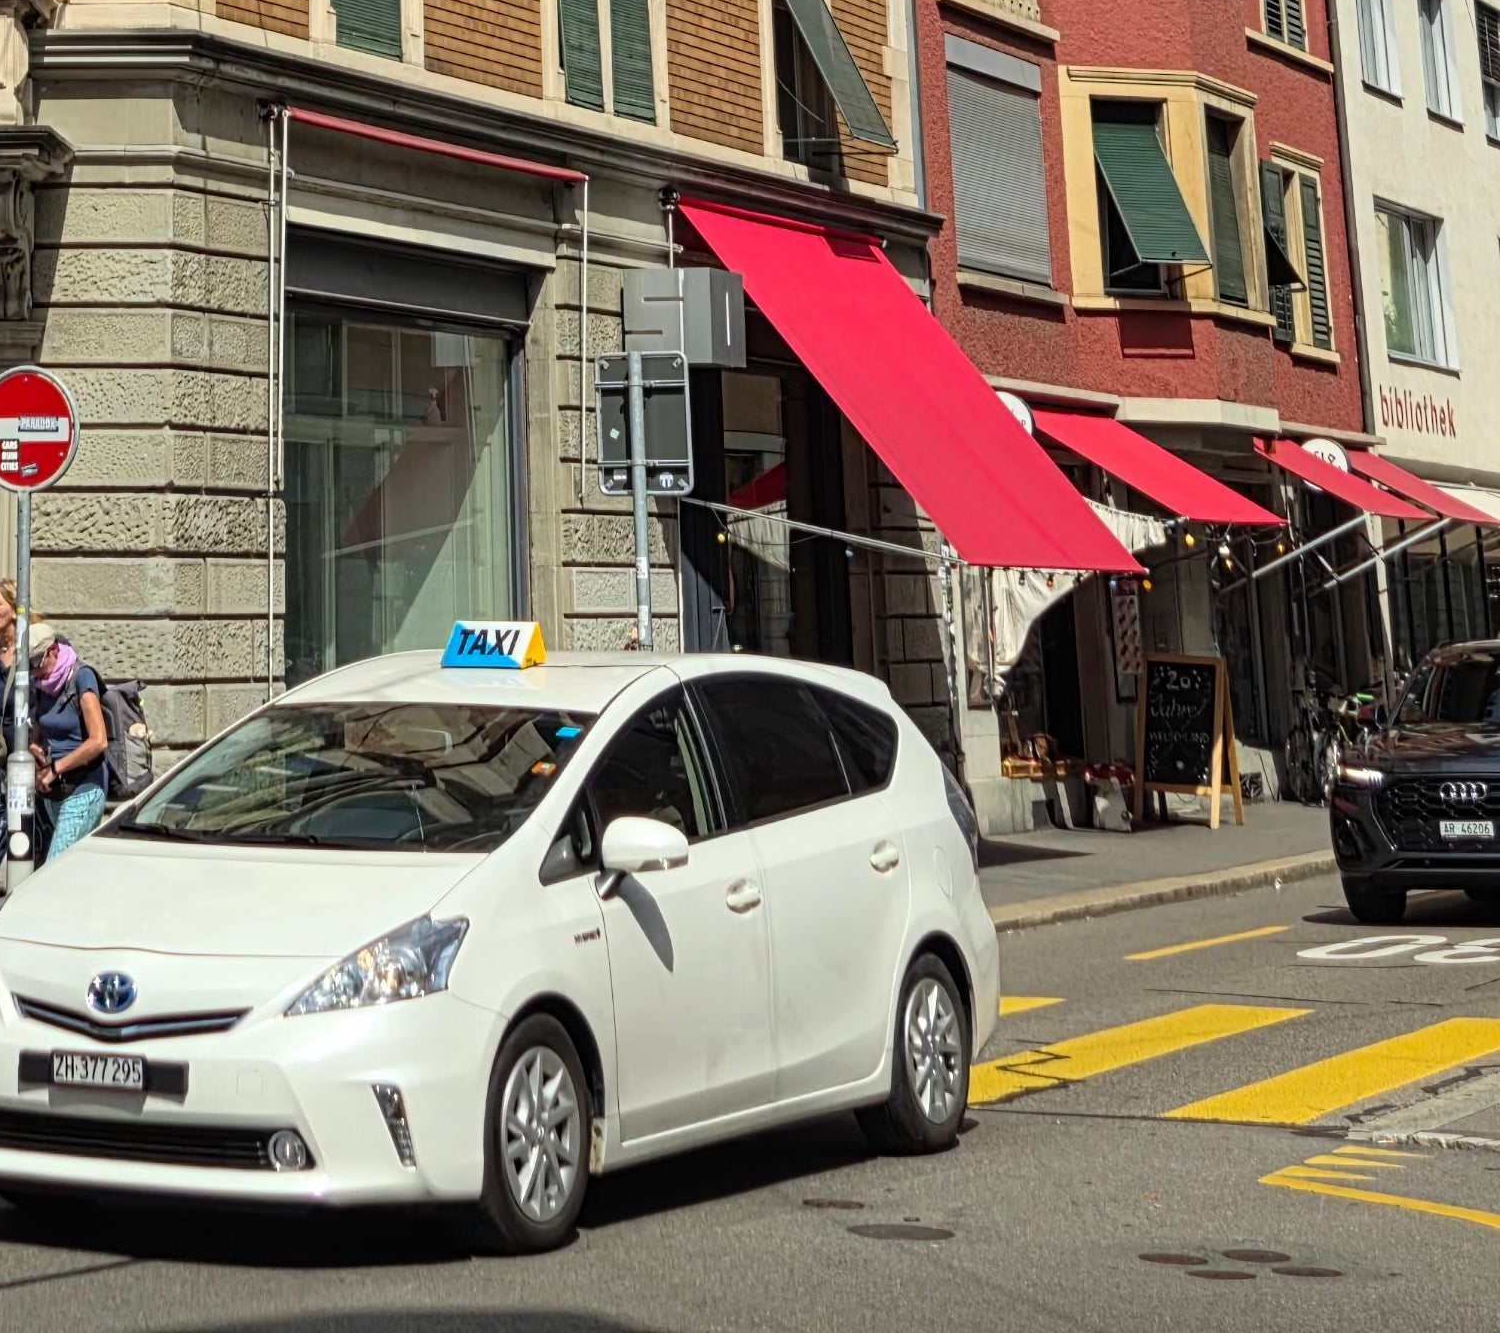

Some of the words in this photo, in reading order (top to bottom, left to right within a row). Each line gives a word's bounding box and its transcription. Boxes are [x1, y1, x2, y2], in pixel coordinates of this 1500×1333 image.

[1379, 384, 1456, 439] bibliothek
[1, 440, 18, 450] CARS
[457, 629, 521, 656] TAXI
[1444, 822, 1455, 833] AR
[1461, 822, 1490, 834] 46206
